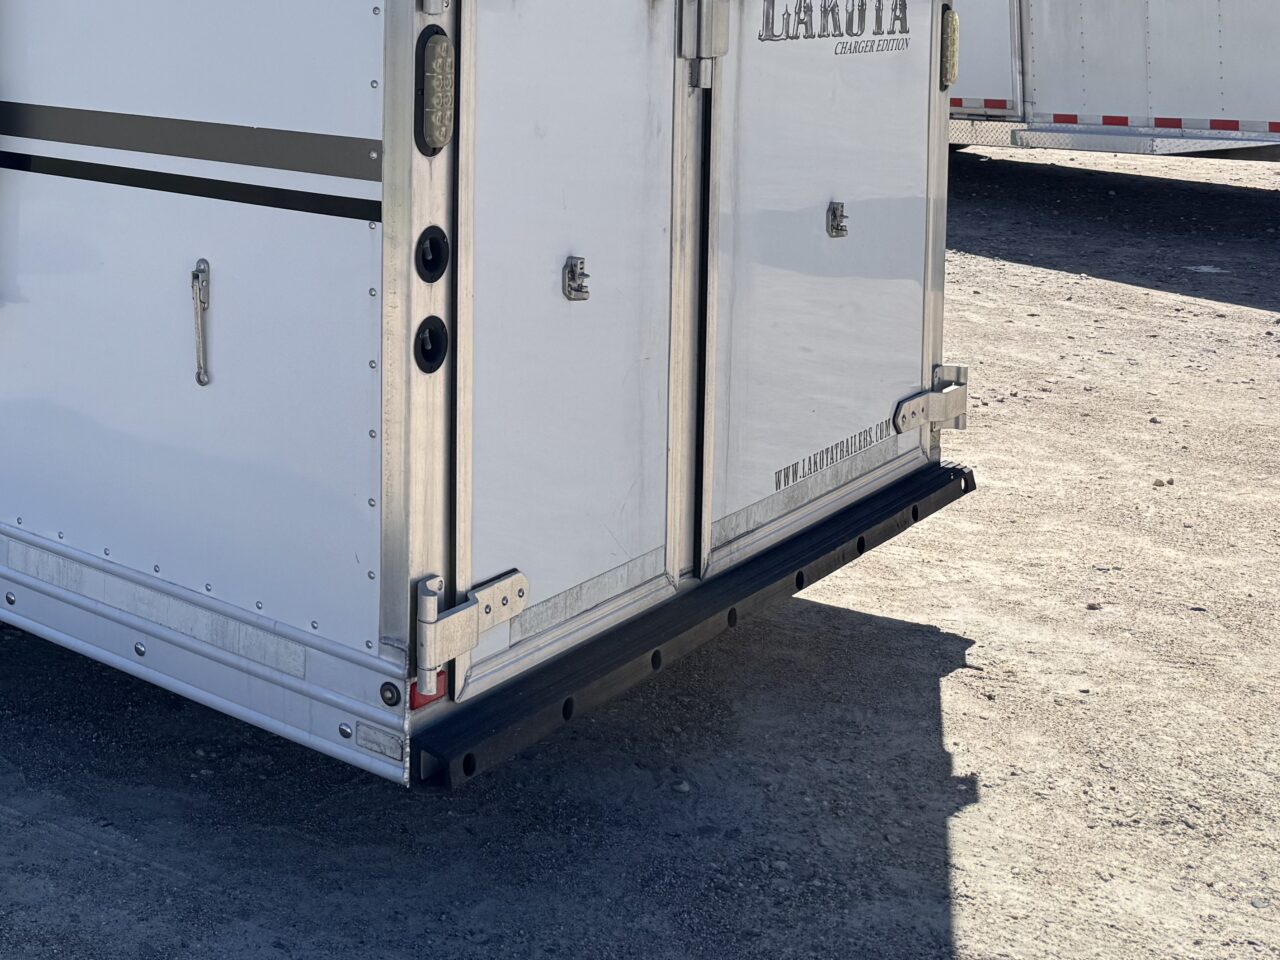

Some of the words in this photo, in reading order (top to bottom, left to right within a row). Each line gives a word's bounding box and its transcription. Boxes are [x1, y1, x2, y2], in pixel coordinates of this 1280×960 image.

[834, 41, 876, 55] CHARGER
[876, 37, 911, 52] EDITION
[774, 418, 891, 492] WWW.LAKOTATRAILERS.COM
